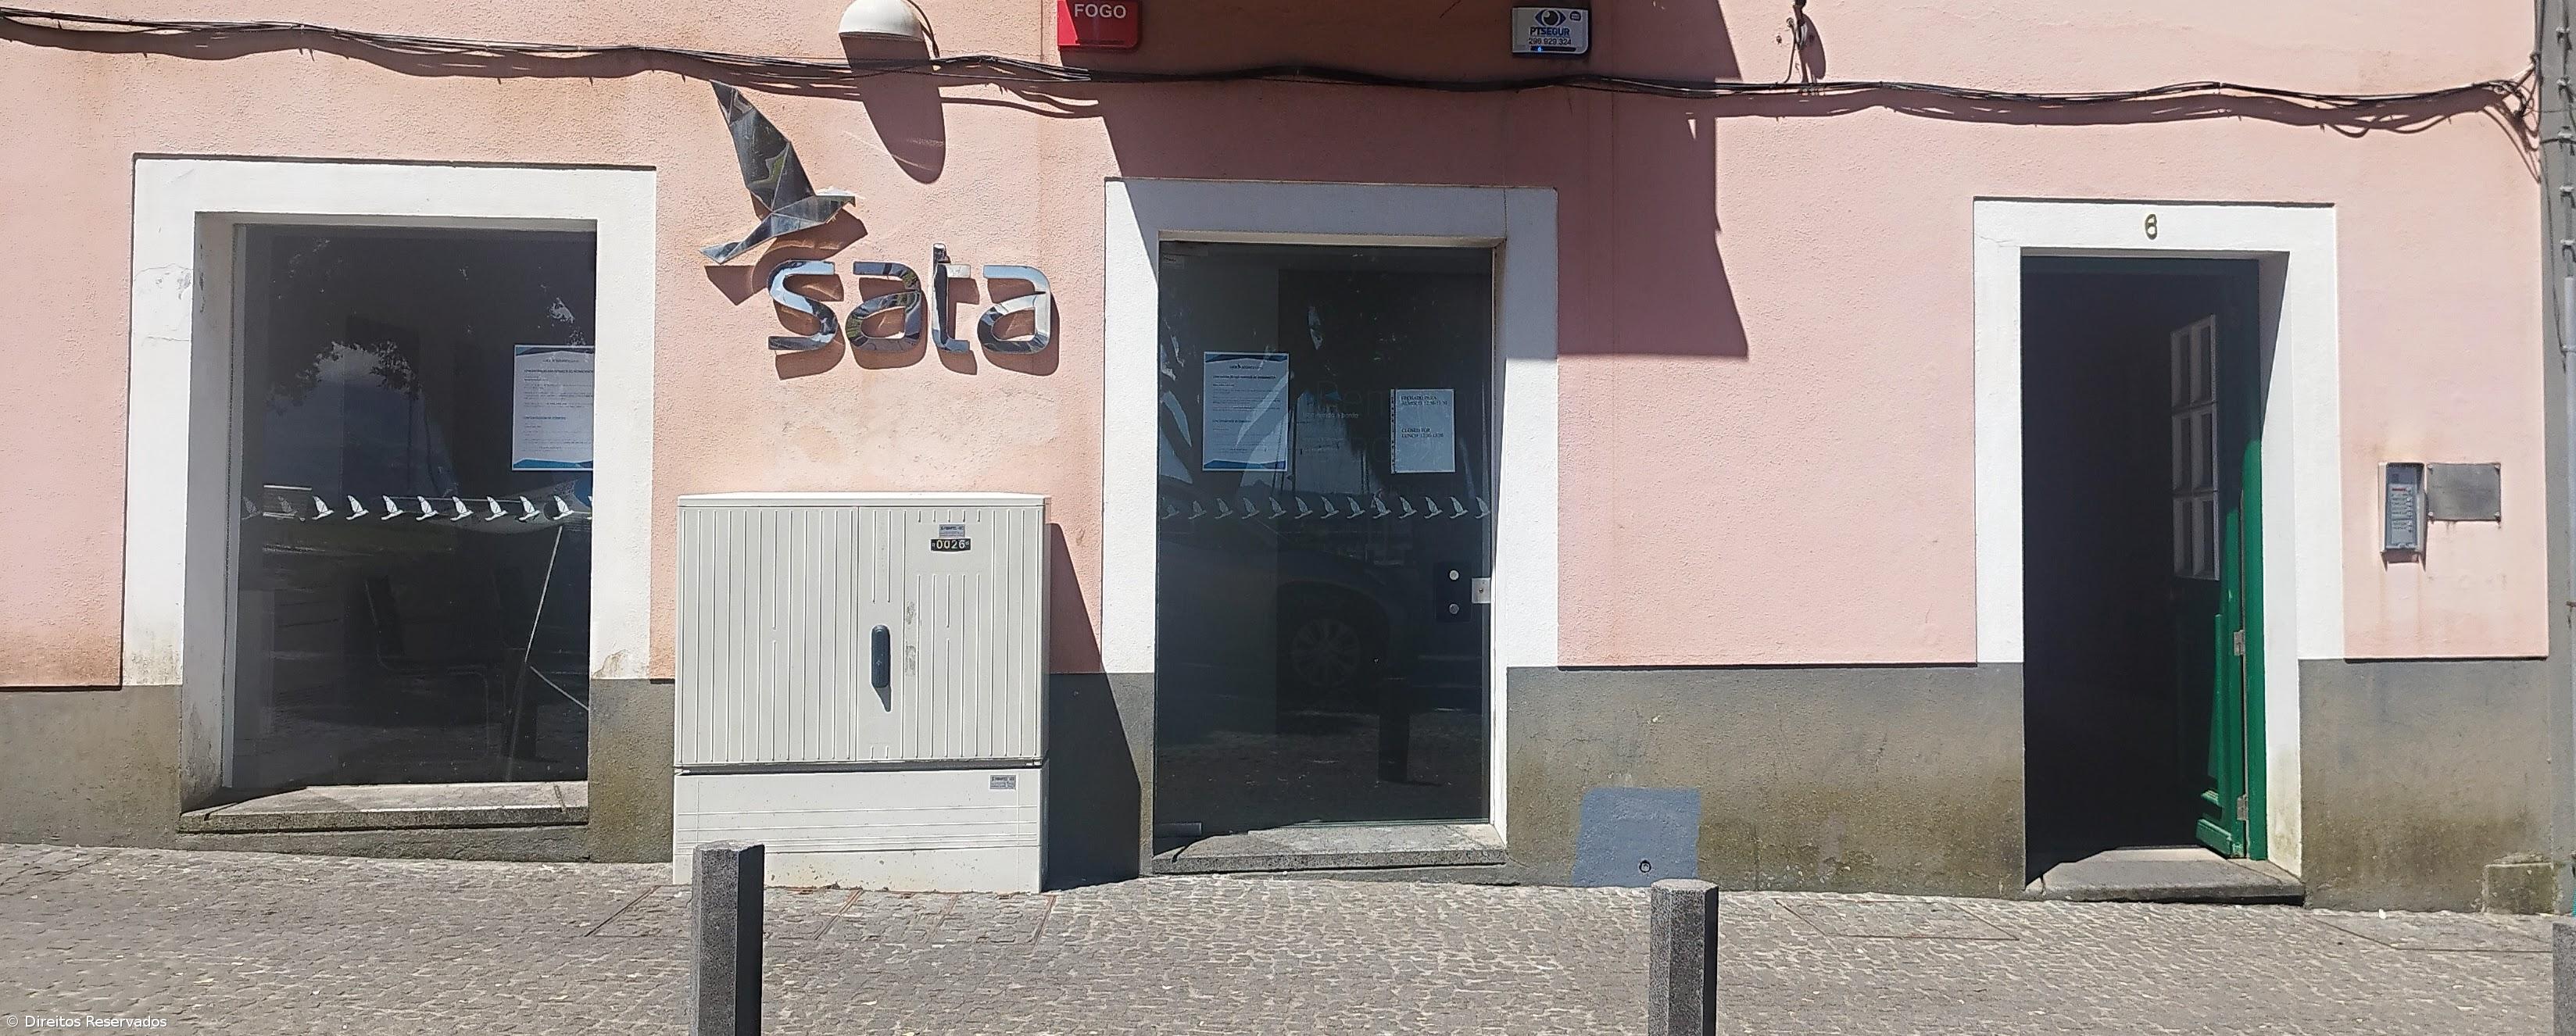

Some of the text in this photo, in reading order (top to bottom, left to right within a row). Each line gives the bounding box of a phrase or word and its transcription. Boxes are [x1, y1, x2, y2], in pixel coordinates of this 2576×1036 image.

[1074, 3, 1126, 19] FOGO
[767, 242, 1050, 353] sata
[936, 539, 965, 549] 0026
